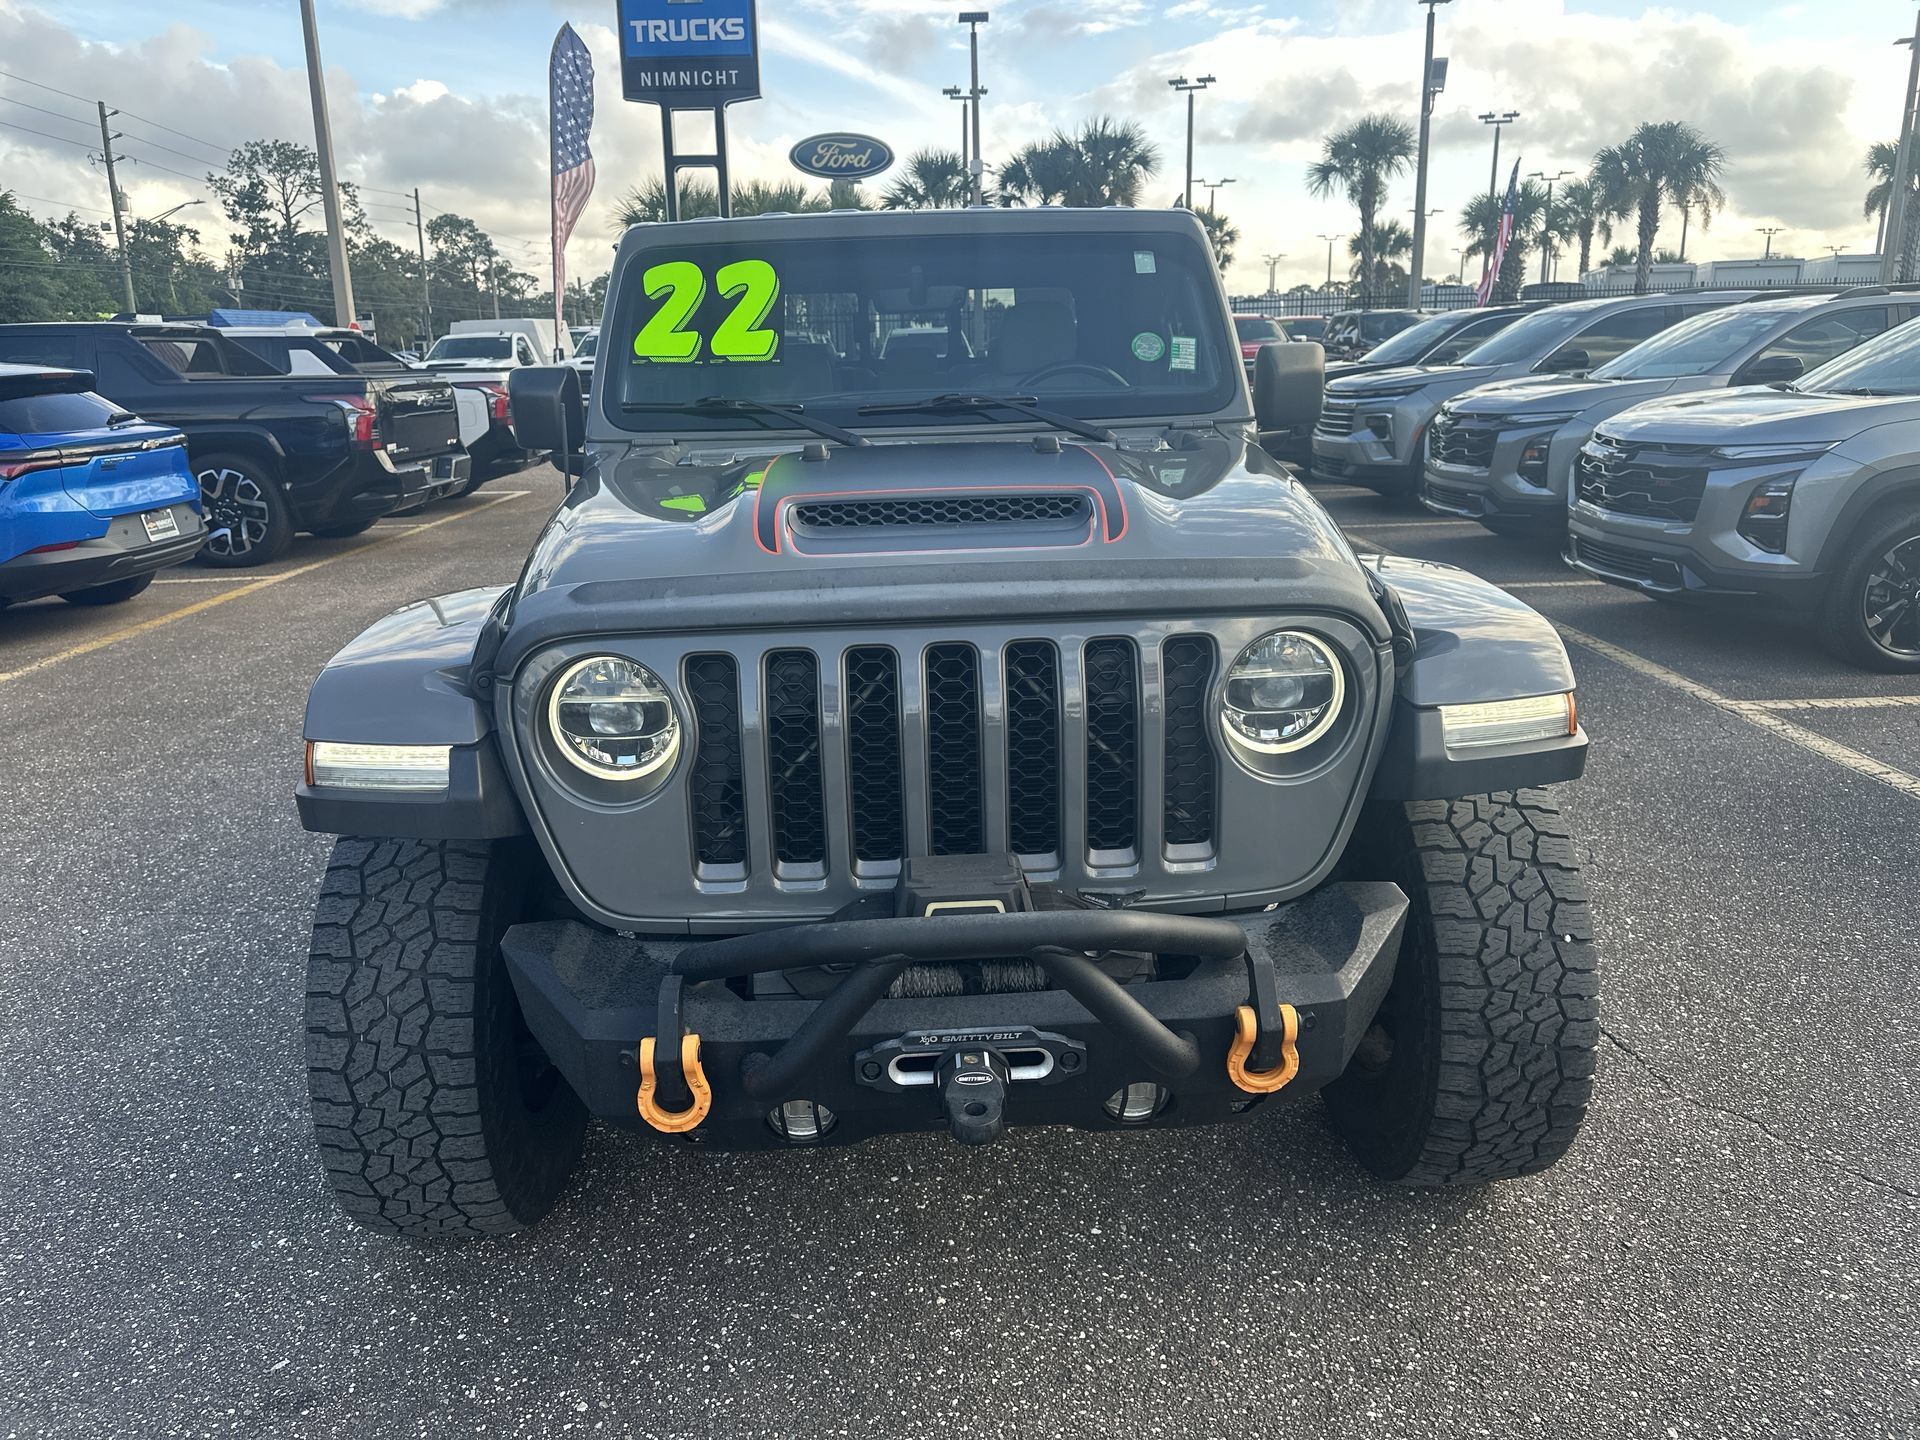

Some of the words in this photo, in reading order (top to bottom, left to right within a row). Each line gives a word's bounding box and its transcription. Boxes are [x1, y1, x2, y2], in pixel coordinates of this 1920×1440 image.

[629, 17, 745, 43] TRUCKS
[640, 70, 739, 87] NIMNICHT
[810, 142, 872, 169] Ford
[634, 260, 781, 362] 22
[941, 1032, 1023, 1043] SMITTYBILT
